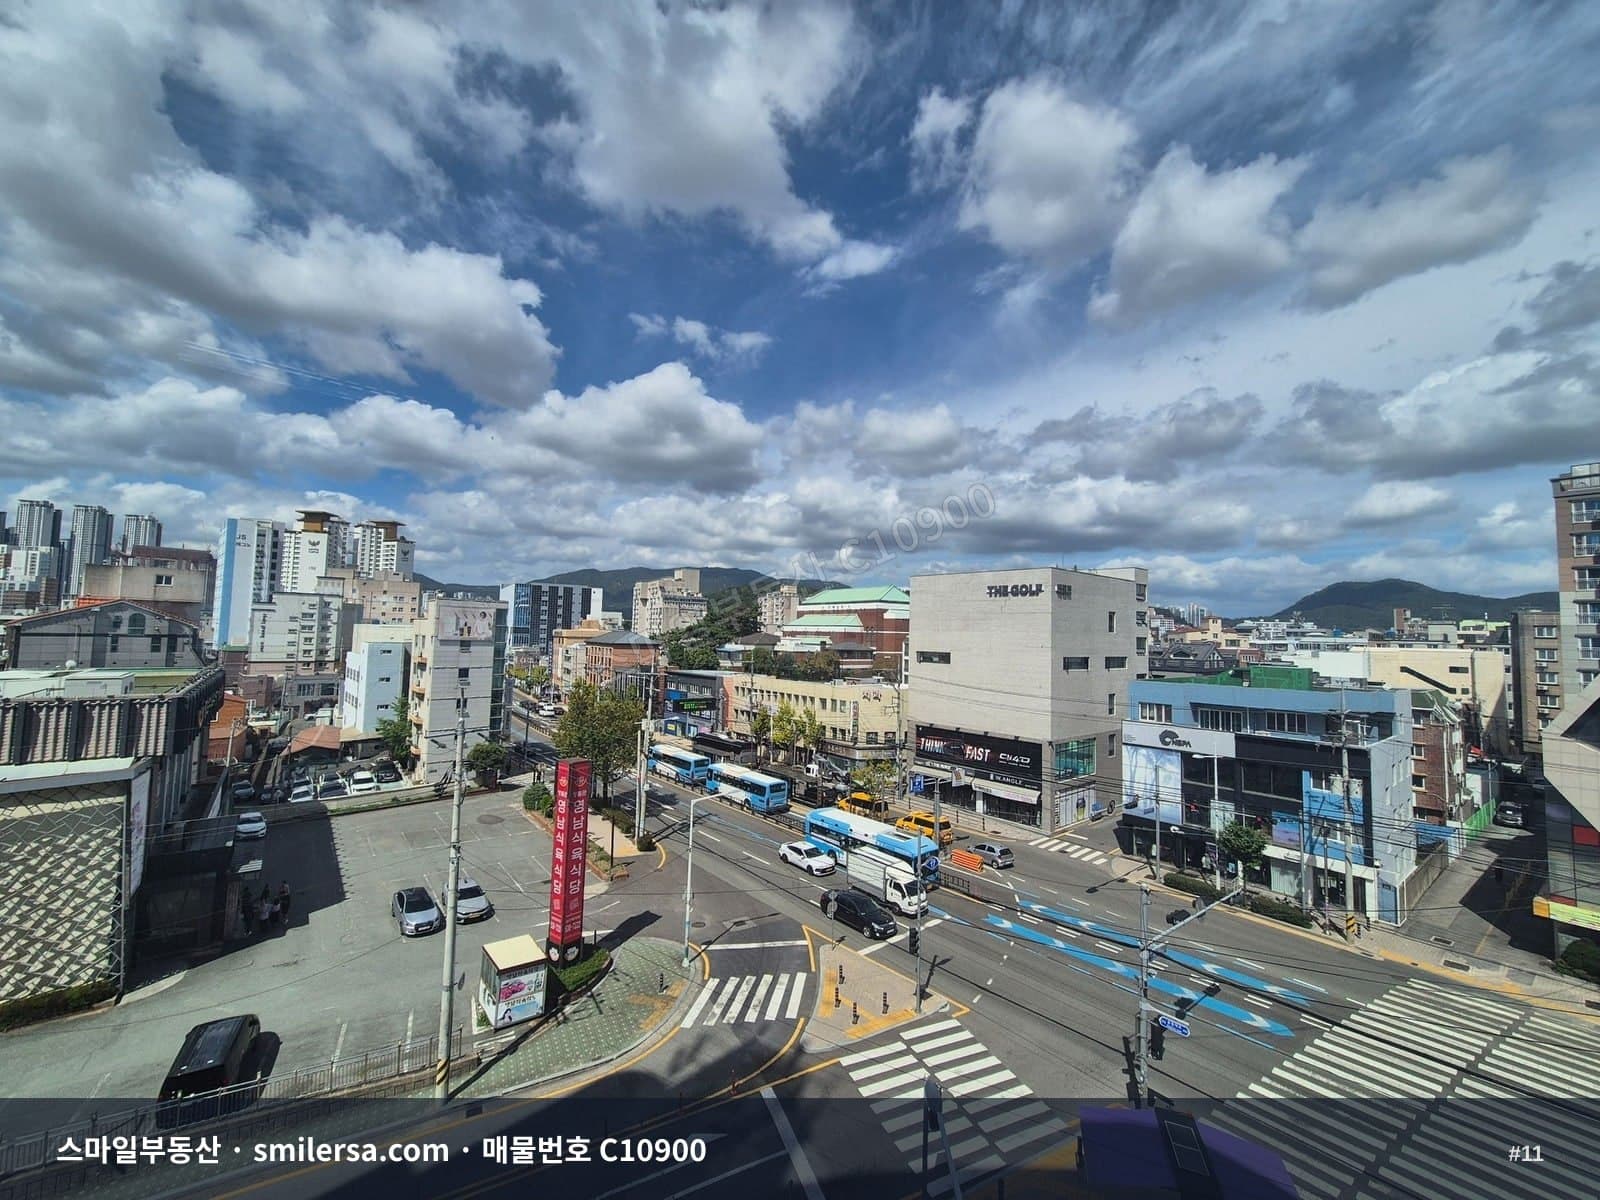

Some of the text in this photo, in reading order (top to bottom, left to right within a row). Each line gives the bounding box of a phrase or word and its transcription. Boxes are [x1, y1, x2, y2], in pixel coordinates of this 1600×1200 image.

[986, 585, 1009, 598] THE
[1010, 583, 1044, 597] GOLF
[919, 737, 991, 763] THINK FAST
[552, 799, 567, 896] 영남식육식당
[568, 799, 586, 896] 영남식육식당
